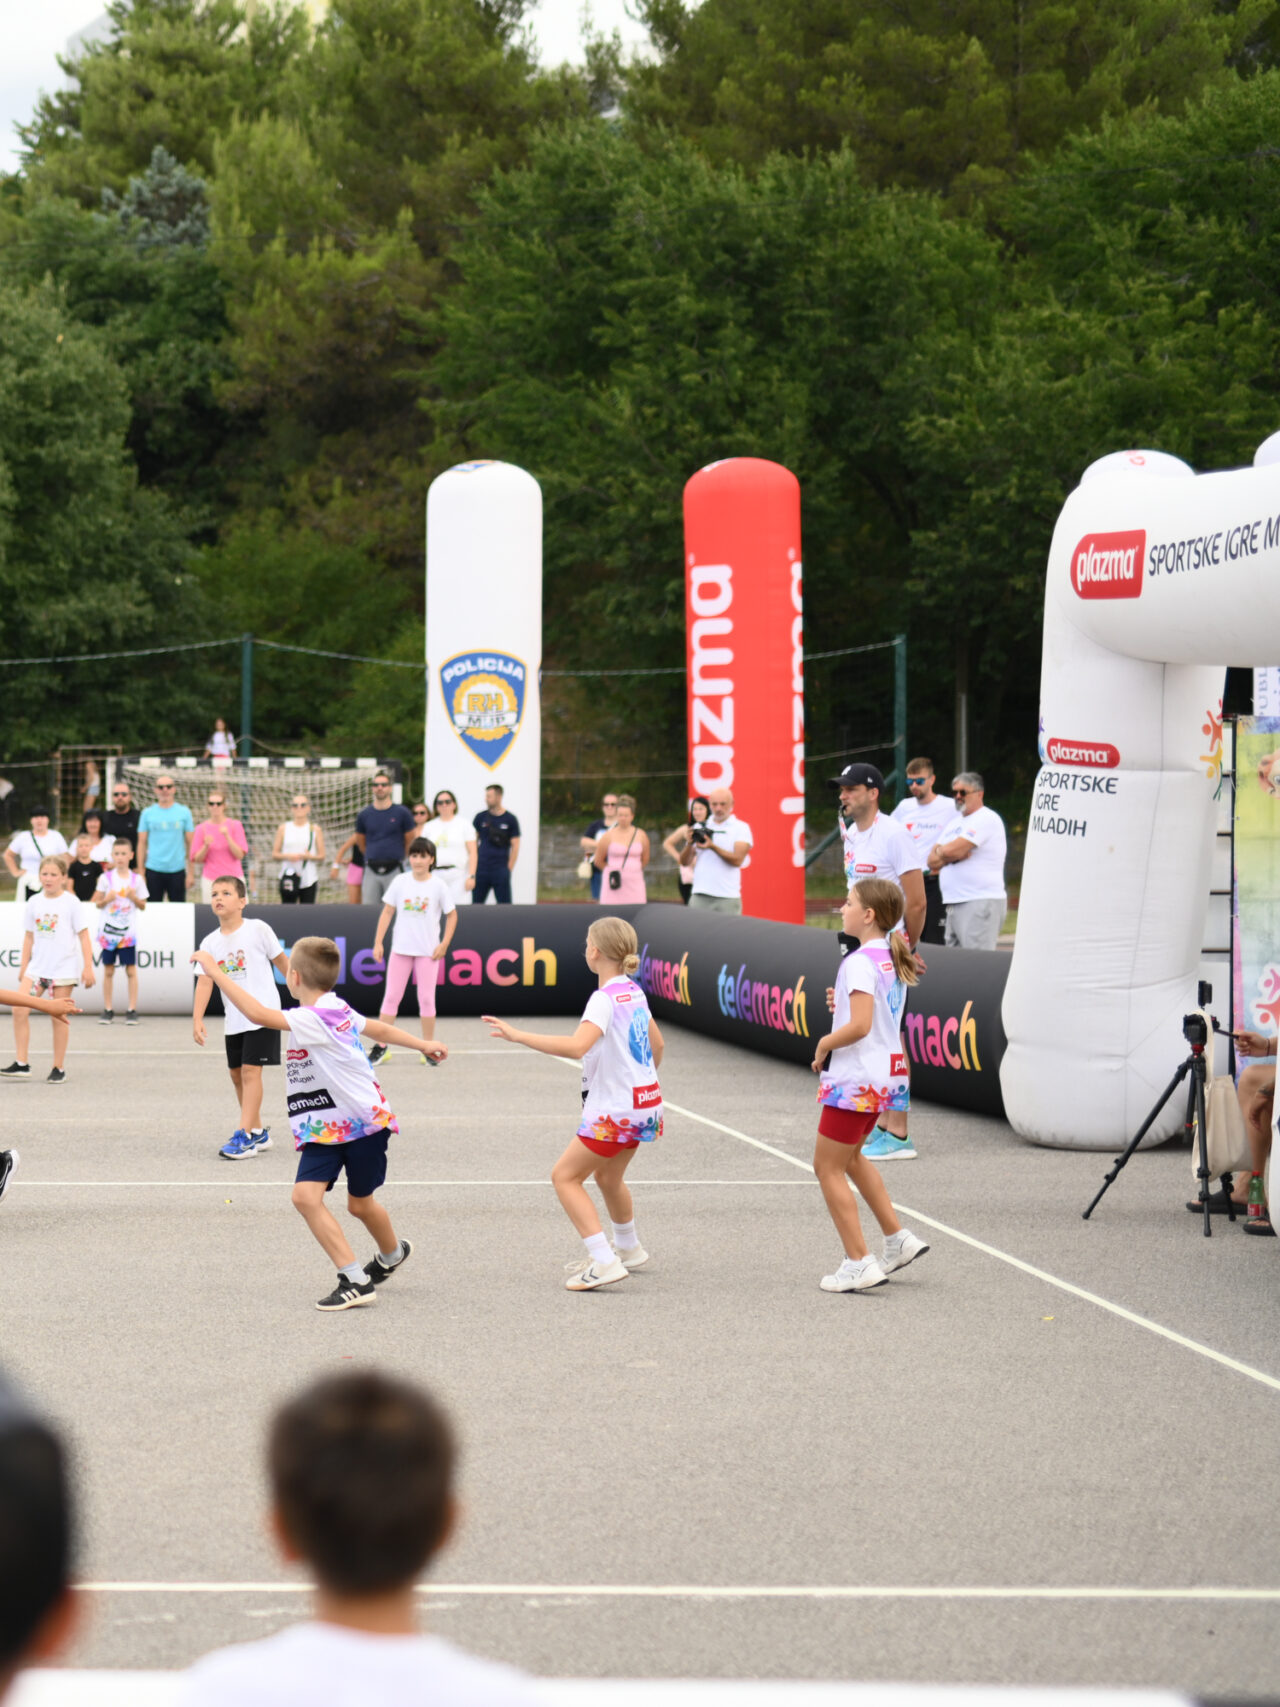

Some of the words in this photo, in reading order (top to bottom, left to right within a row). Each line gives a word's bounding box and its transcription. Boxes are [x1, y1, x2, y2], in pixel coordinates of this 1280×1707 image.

[1076, 544, 1136, 590] plazma
[1149, 532, 1223, 577] SPORTSKE
[1225, 520, 1261, 561] IGRE
[442, 657, 524, 683] POLICIJA
[467, 693, 503, 712] RH
[1050, 743, 1109, 764] plazma
[1039, 770, 1119, 794] SPORTSKE
[1036, 793, 1060, 811] IGRE
[1032, 816, 1087, 837] MLADIH
[718, 963, 810, 1038] telemach
[904, 1000, 982, 1071] mach
[288, 1095, 329, 1112] emach
